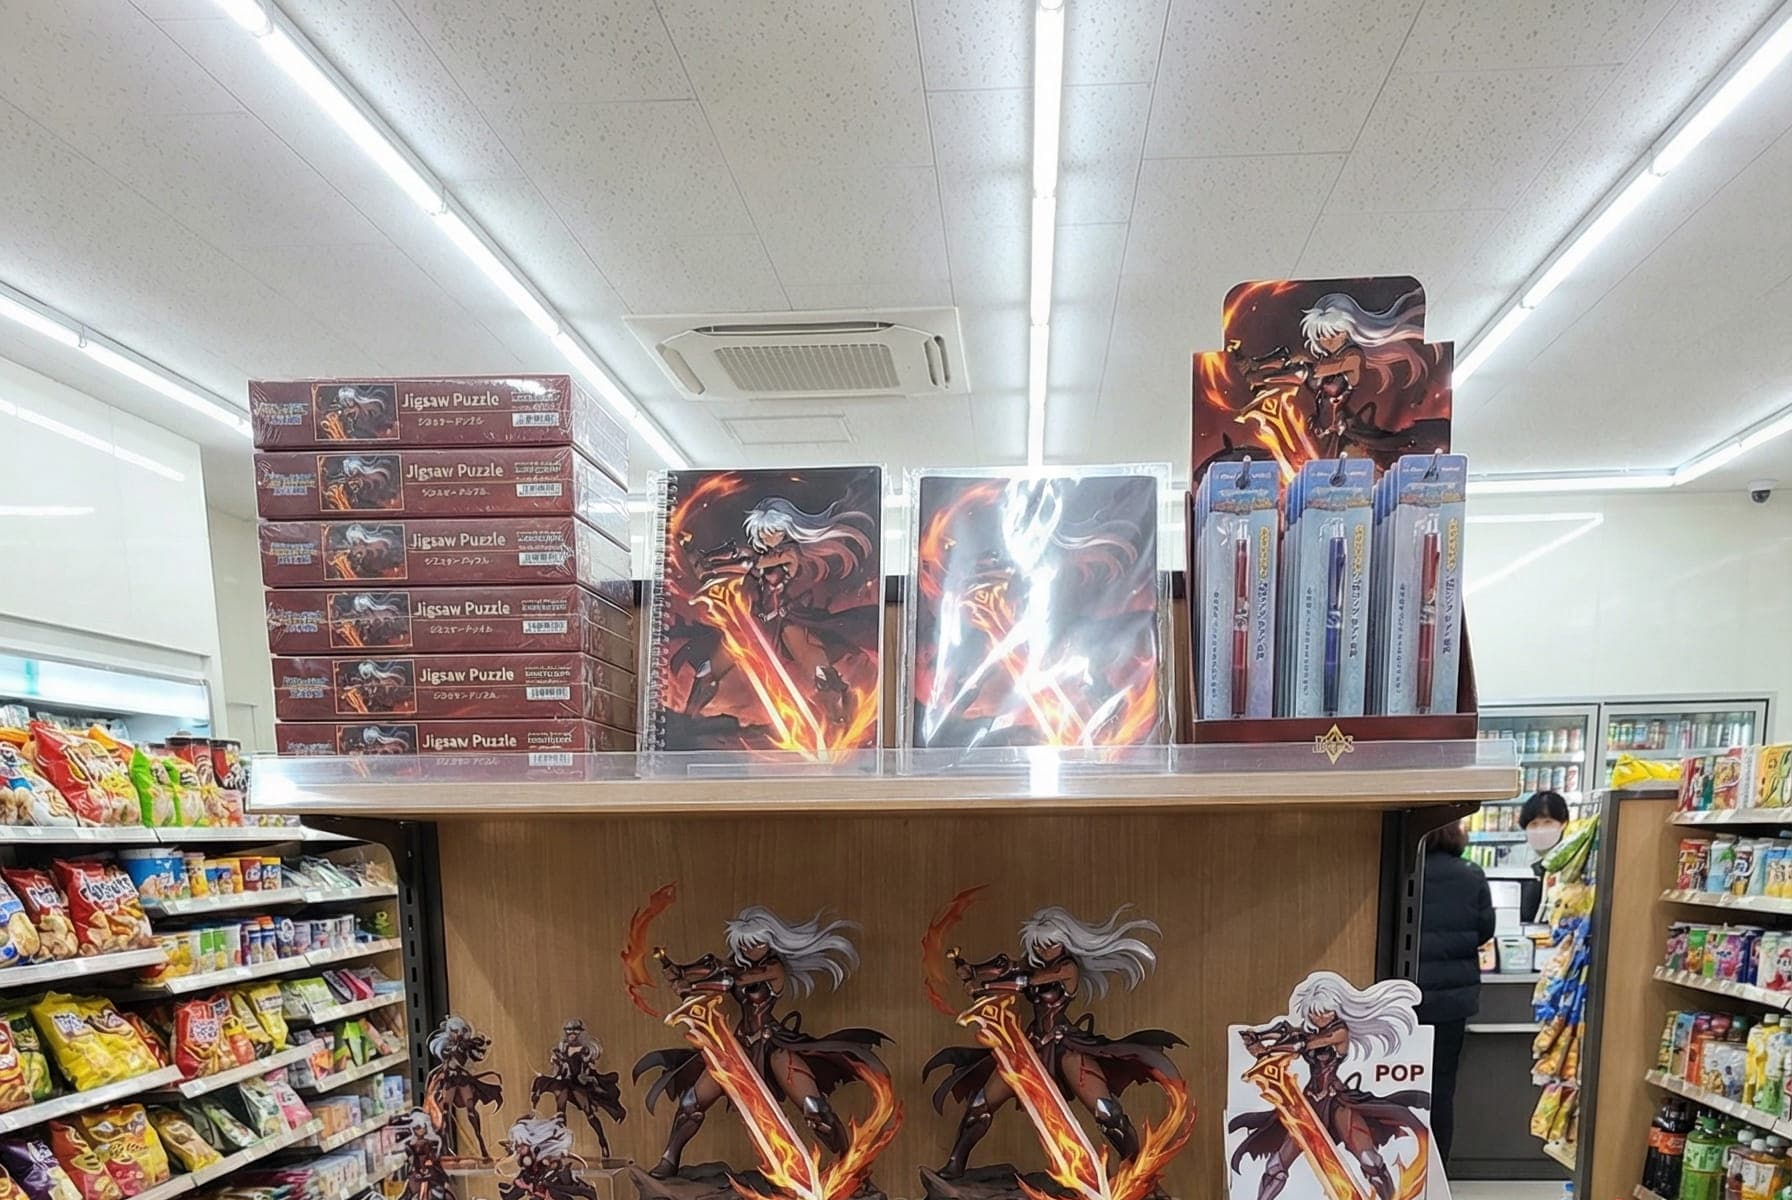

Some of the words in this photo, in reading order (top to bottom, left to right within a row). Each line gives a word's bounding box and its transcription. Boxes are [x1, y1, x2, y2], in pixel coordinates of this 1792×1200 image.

[402, 391, 449, 412] Jigsaw
[453, 390, 499, 407] Puzzle
[457, 462, 504, 478] Puzzle
[411, 533, 456, 550] Jigsaw
[460, 531, 506, 547] Puzzle
[414, 601, 461, 618] Jigsaw
[465, 599, 511, 616] Puzzle
[419, 668, 466, 686] Jigsaw
[469, 666, 515, 682] Puzzle
[422, 734, 469, 751] Jigsaw
[472, 733, 517, 748] Puzzle
[1375, 1064, 1425, 1082] POP
